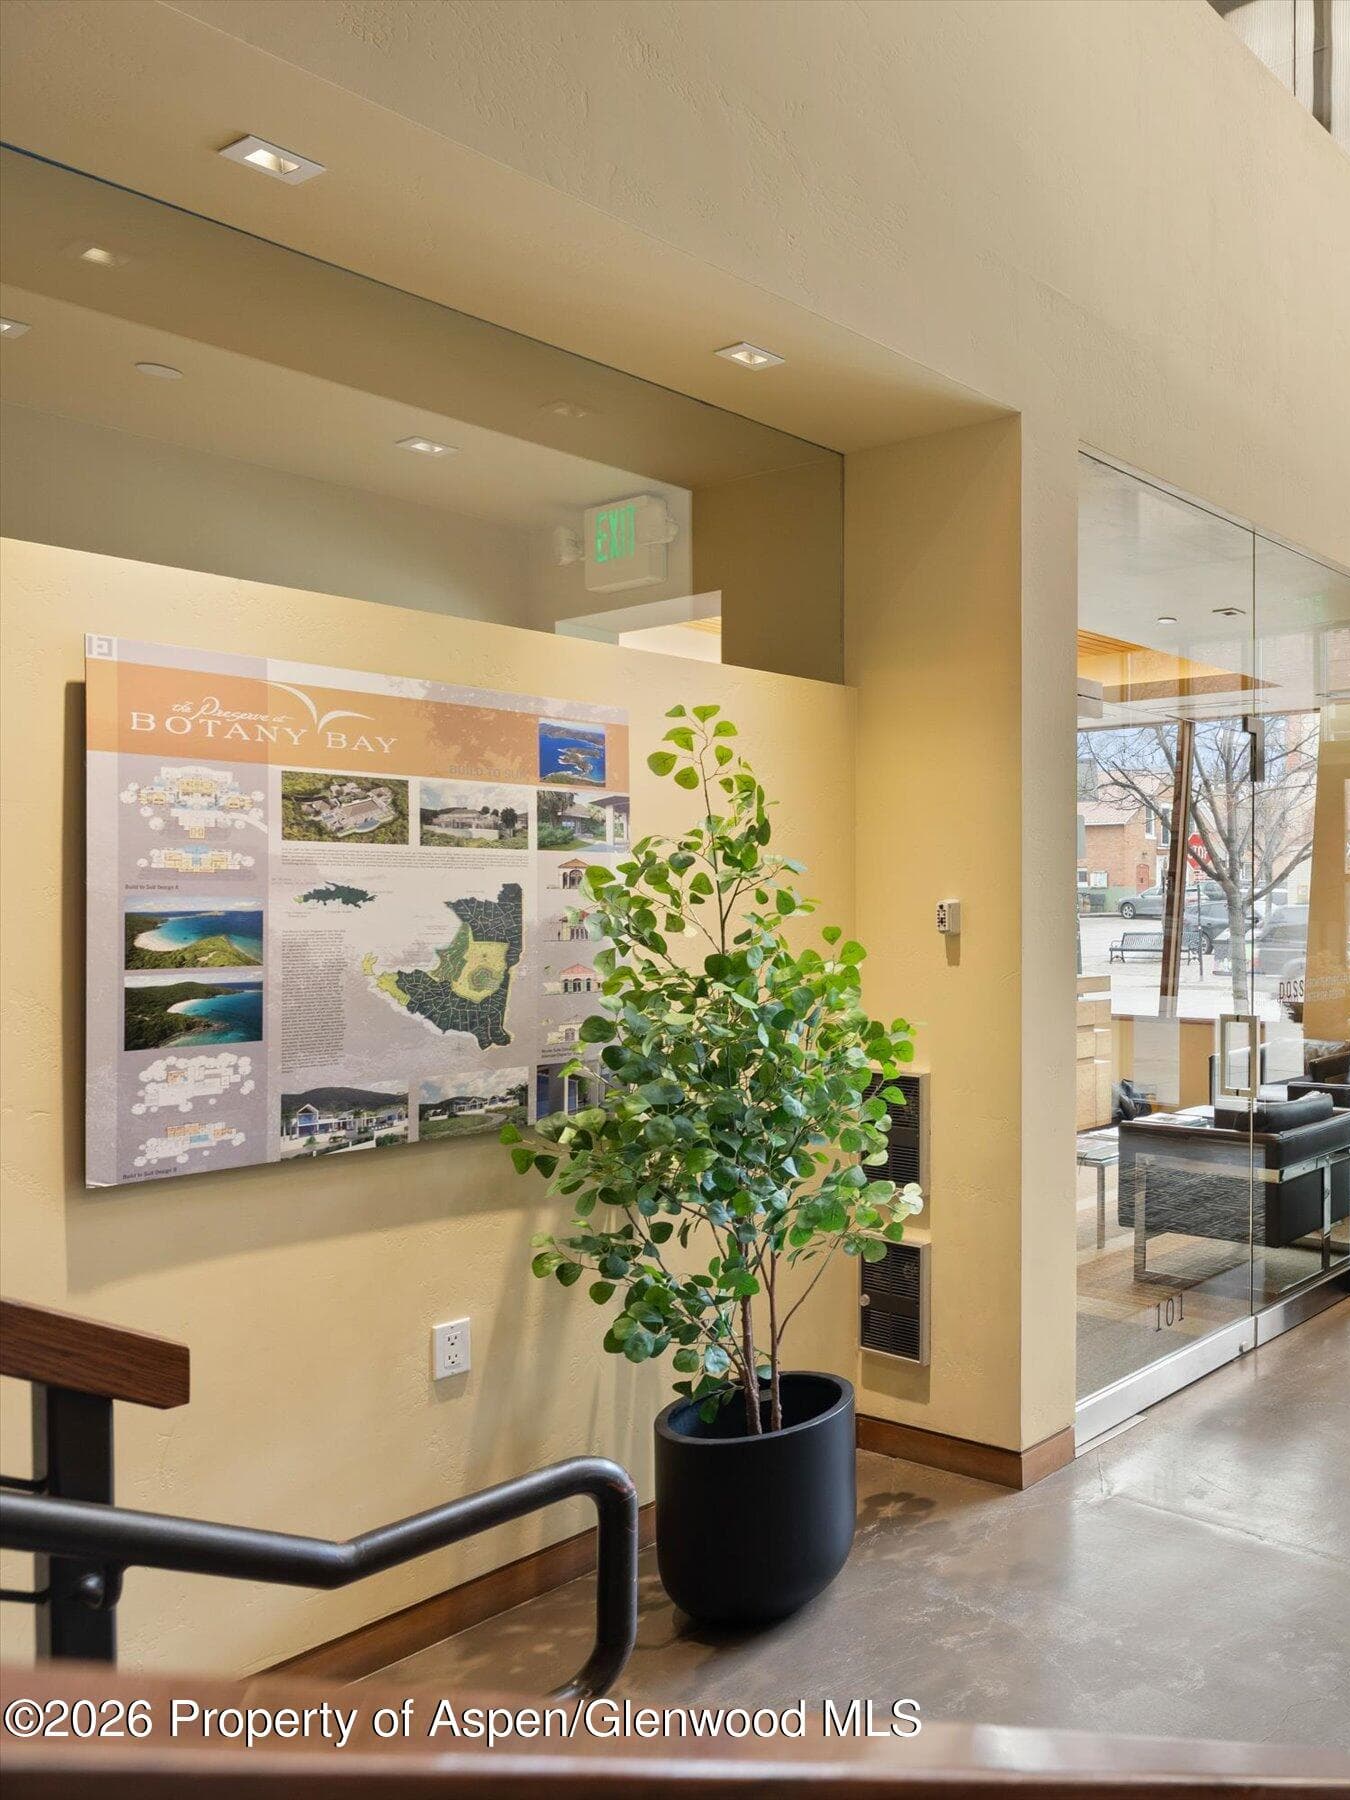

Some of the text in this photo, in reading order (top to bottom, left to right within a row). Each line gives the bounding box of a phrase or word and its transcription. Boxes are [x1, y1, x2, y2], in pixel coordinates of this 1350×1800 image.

[594, 503, 636, 563] EXIT
[130, 710, 399, 754] BOTANY BAY
[1155, 1292, 1184, 1333] 101
